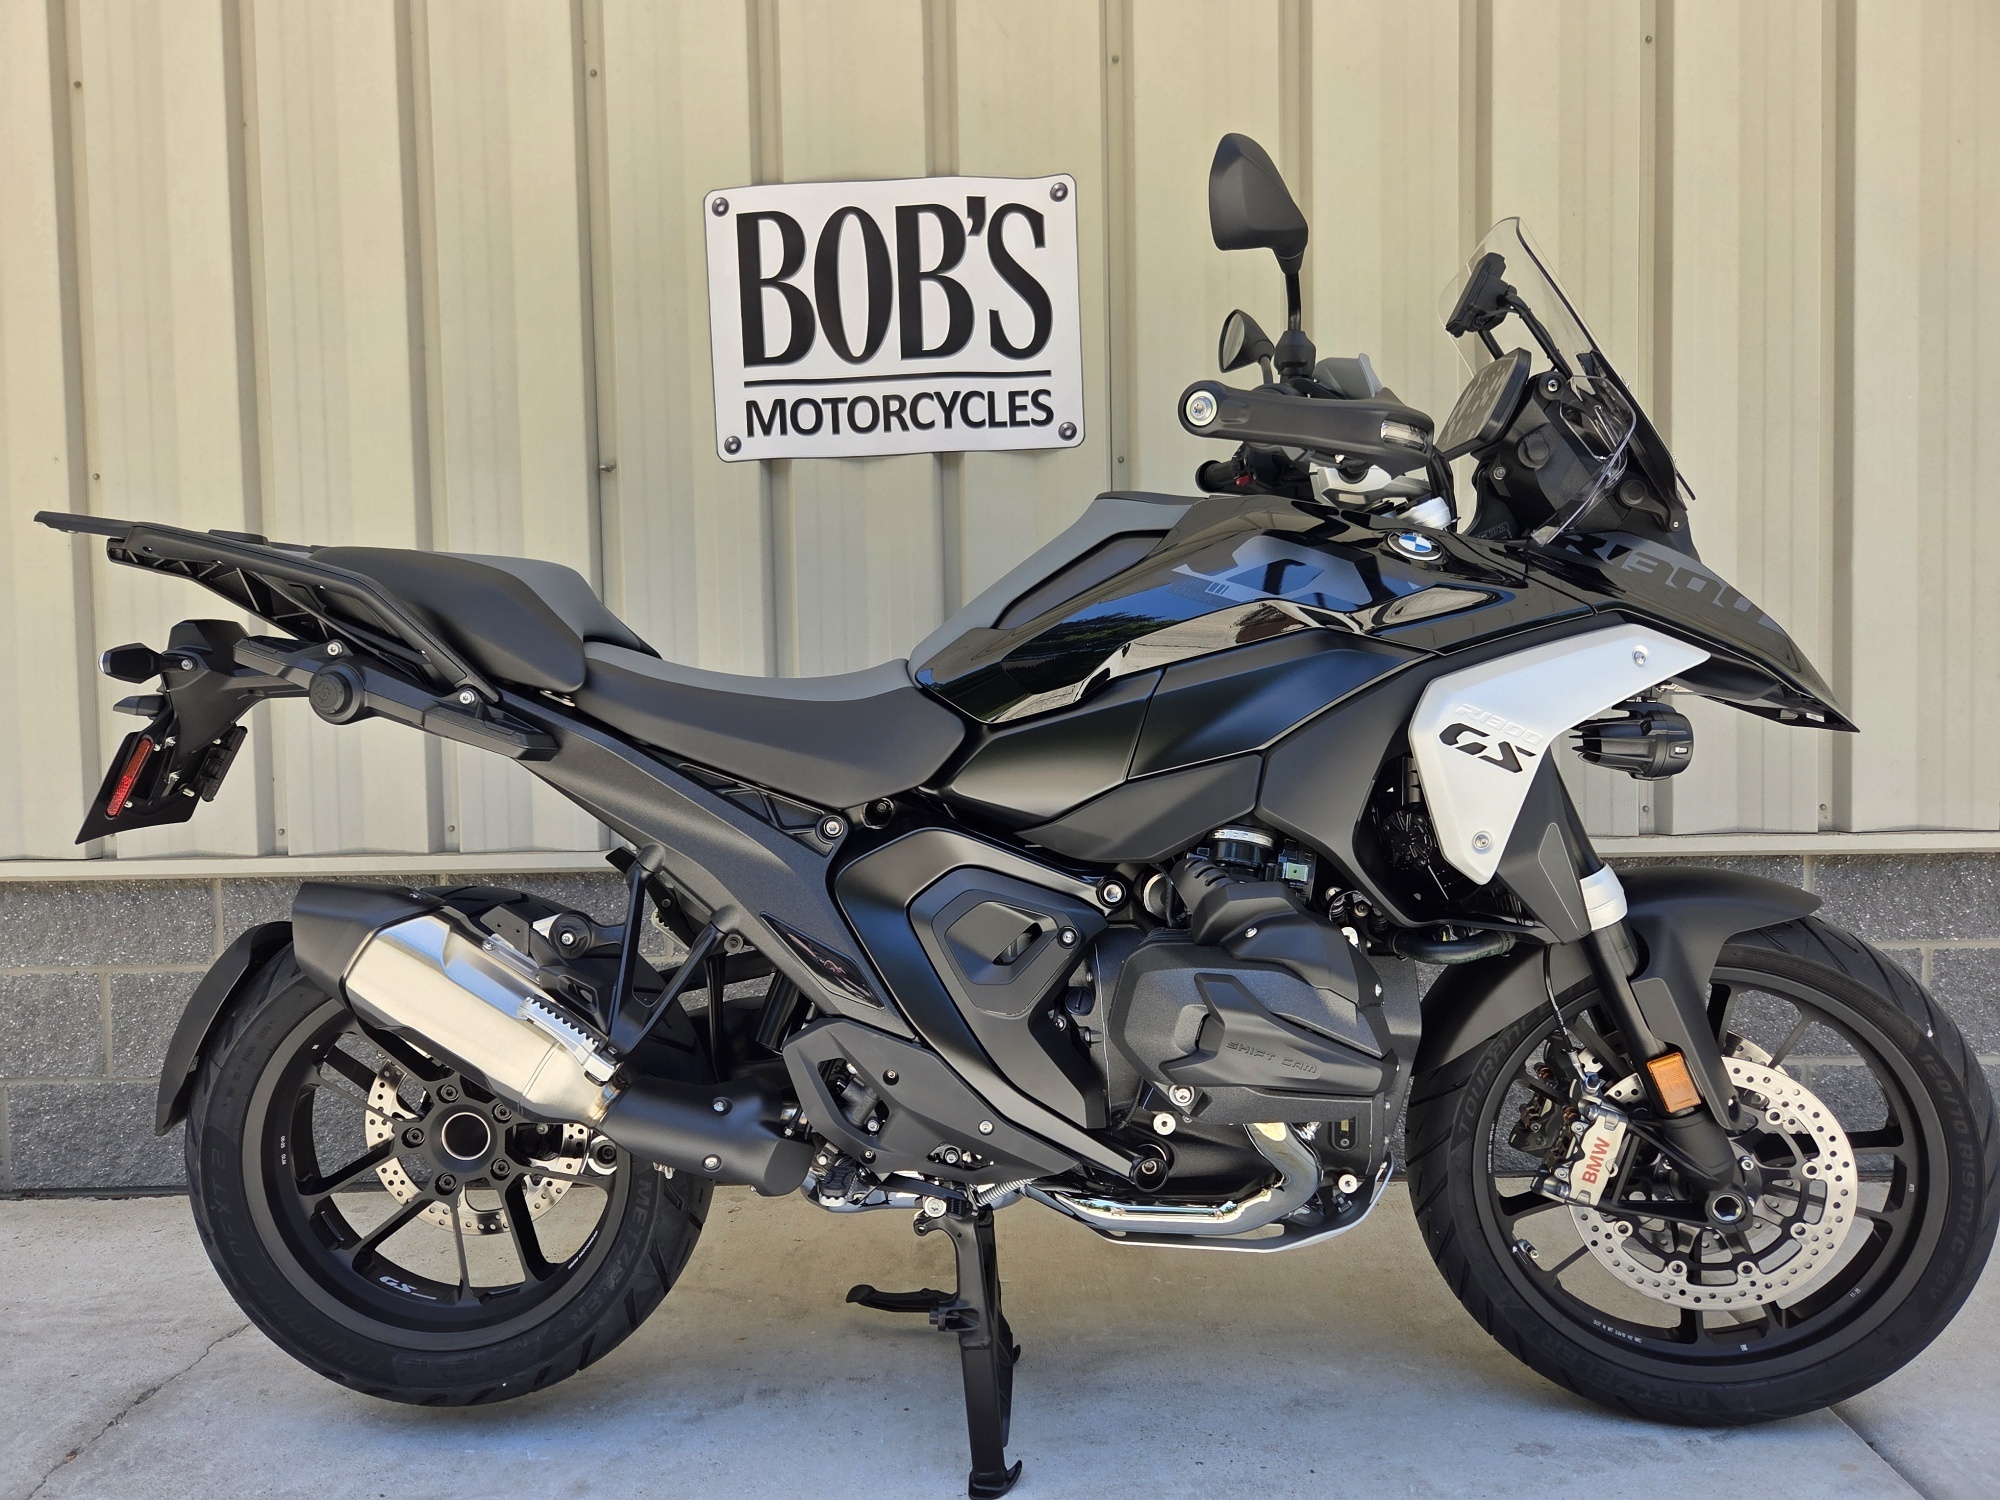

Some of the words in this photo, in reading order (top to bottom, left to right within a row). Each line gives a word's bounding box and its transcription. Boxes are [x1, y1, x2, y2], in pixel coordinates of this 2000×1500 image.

[736, 196, 1054, 368] BOB'S
[745, 389, 1055, 438] MOTORCYCLES
[1439, 722, 1538, 773] GS
[1455, 703, 1544, 747] R1300
[1226, 1041, 1277, 1061] SHIFT
[1281, 1058, 1319, 1074] CAM
[1581, 1136, 1610, 1184] BMW
[379, 1276, 418, 1293] GS
